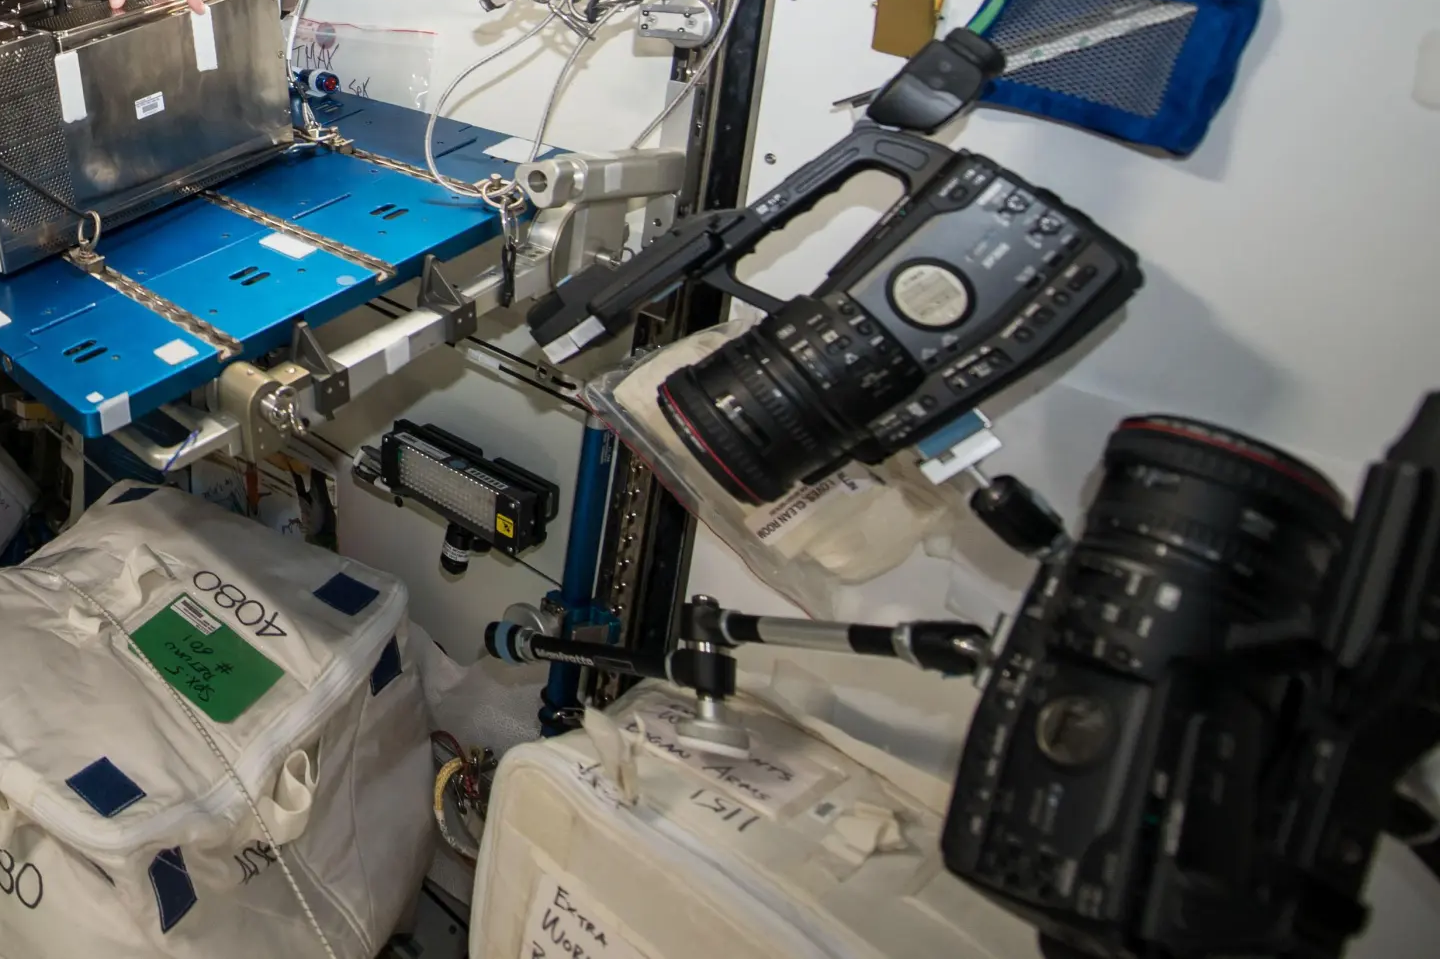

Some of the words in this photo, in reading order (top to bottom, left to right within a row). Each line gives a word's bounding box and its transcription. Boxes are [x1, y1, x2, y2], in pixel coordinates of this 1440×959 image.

[778, 500, 808, 524] CLEAN
[756, 516, 781, 540] ROOM
[192, 570, 288, 637] 4080
[535, 645, 596, 668] Manfrotto
[541, 908, 594, 959] WOR
